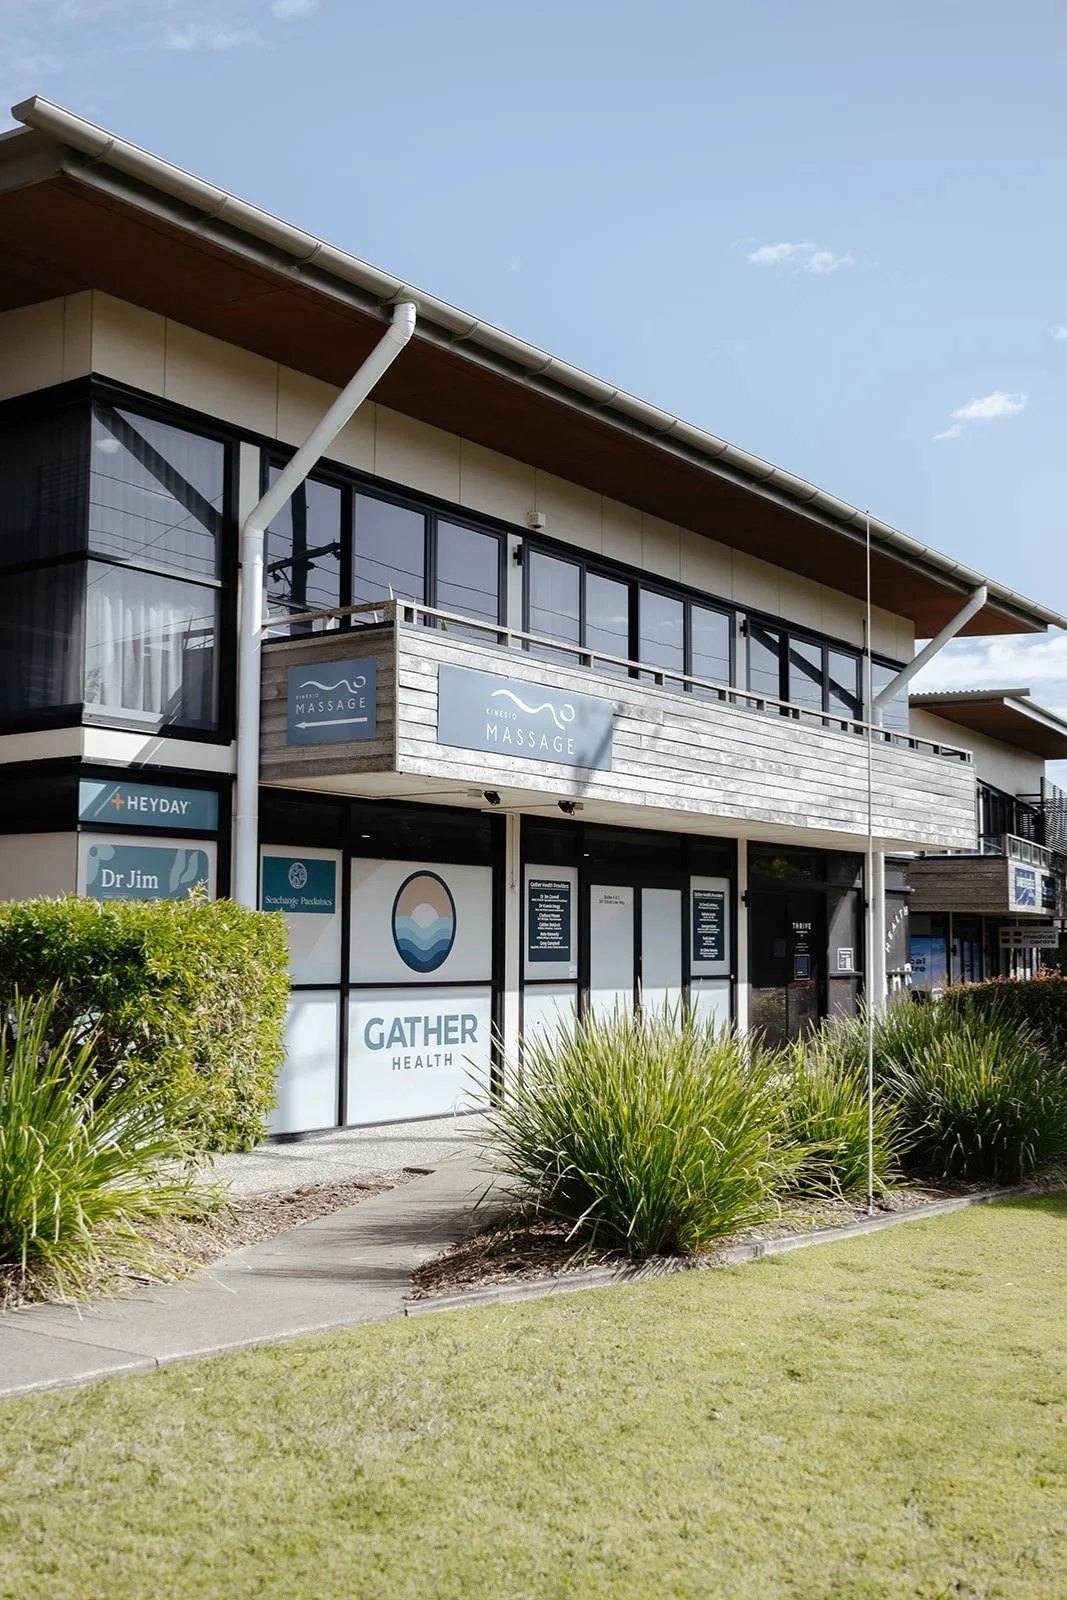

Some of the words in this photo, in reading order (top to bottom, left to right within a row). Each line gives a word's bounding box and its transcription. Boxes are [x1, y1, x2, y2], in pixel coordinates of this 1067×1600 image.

[295, 697, 366, 715] MASSAGE
[486, 708, 518, 721] KINESIO
[486, 723, 575, 755] MASSAGE
[127, 795, 189, 815] HEYDAY
[101, 869, 124, 888] Dr
[126, 870, 159, 889] Jim
[265, 895, 299, 909] Seachange
[792, 922, 811, 930] THRIVE
[884, 905, 909, 953] HEALTH
[364, 1014, 478, 1050] GATHER
[392, 1053, 453, 1070] HEALTH
